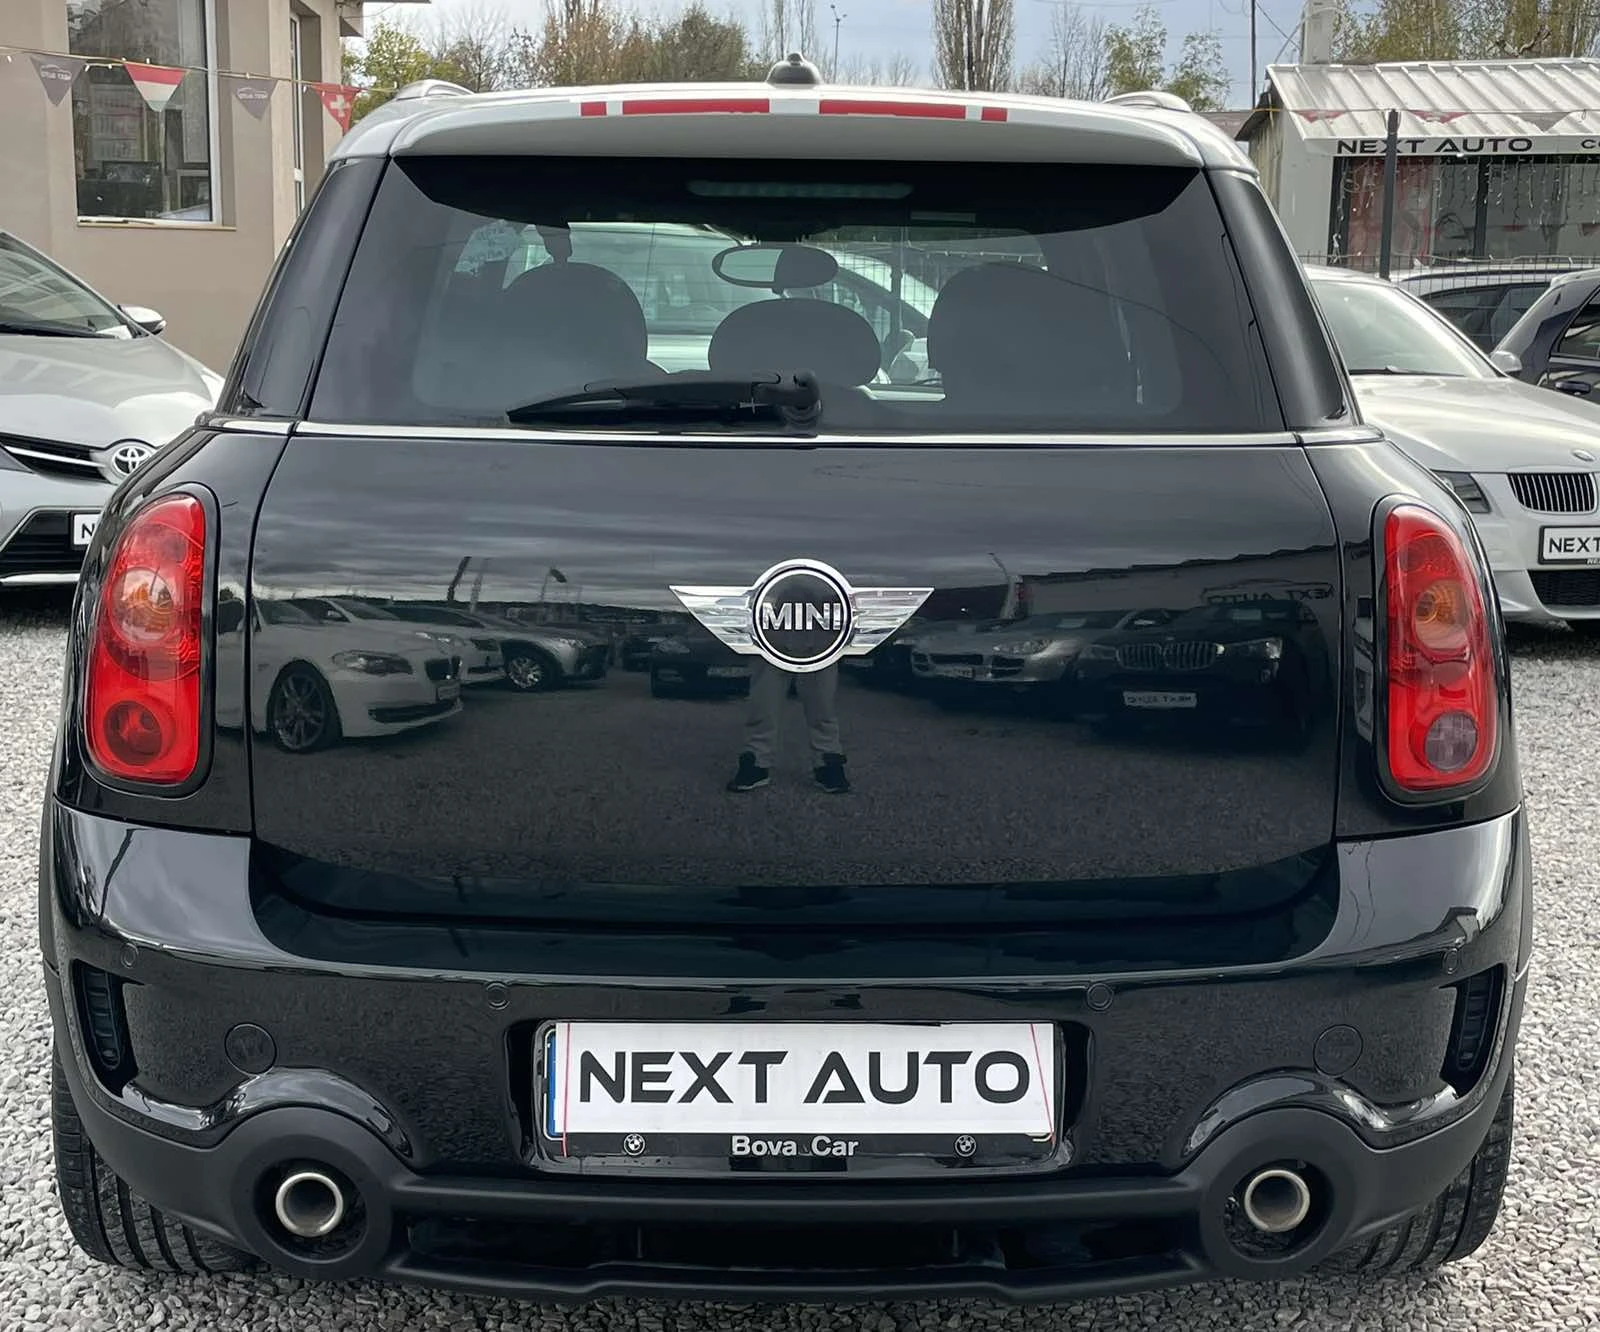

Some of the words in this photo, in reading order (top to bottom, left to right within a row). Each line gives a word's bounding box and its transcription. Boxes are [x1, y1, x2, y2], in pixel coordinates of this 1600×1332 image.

[1435, 138, 1533, 153] AUTO
[1549, 536, 1600, 553] NEXT
[762, 602, 842, 631] MINI
[579, 1050, 787, 1104] NEXT
[803, 1050, 1030, 1104] AUTO
[731, 1136, 797, 1156] Bova
[810, 1136, 859, 1156] Car
